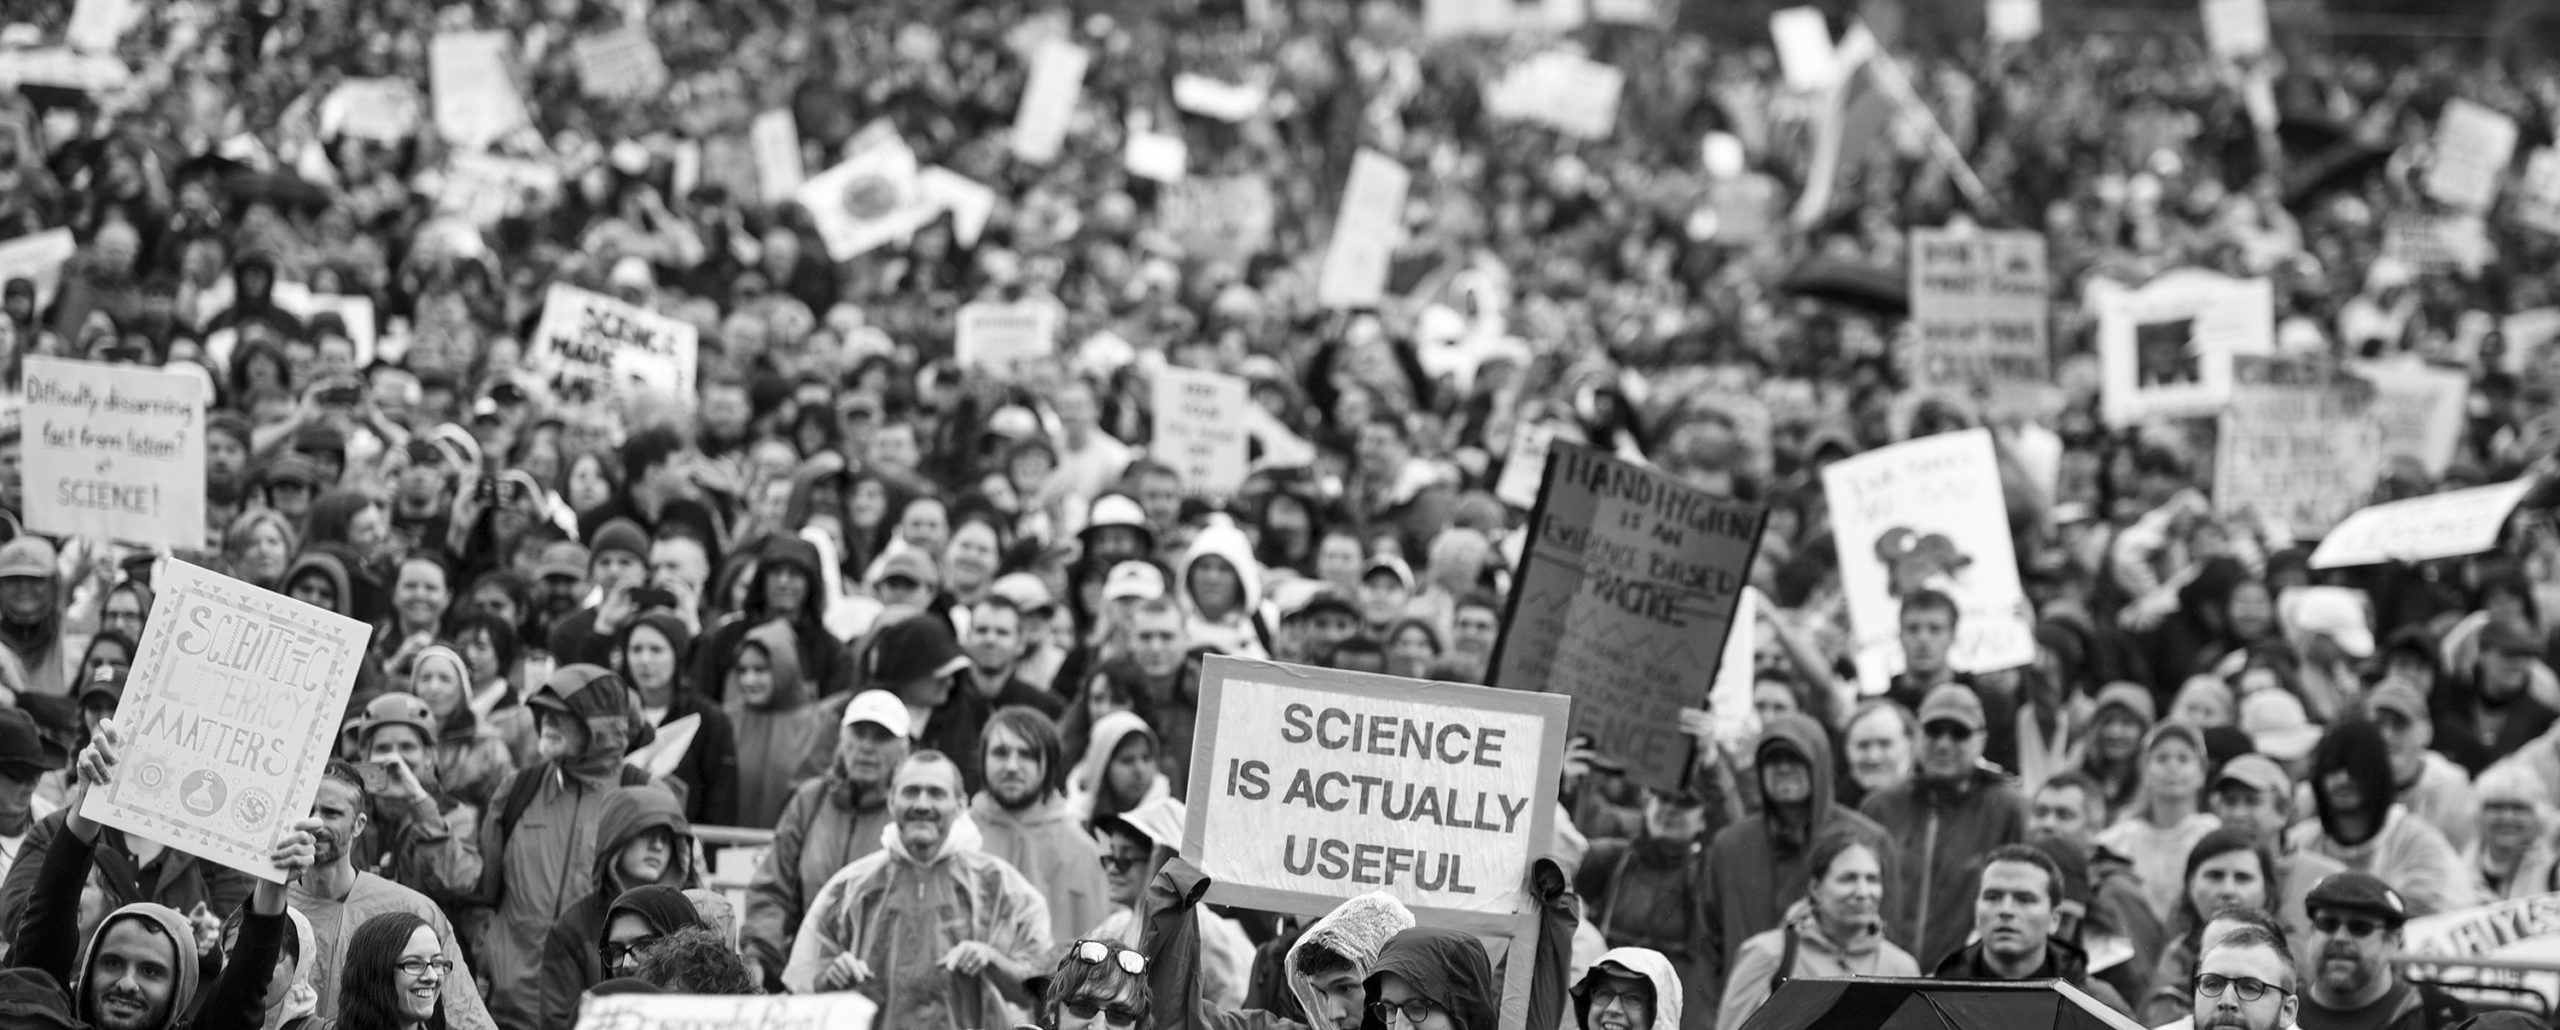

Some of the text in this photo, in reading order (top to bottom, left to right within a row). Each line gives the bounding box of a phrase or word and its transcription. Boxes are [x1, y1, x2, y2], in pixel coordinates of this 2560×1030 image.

[1619, 509, 1684, 549] IS AN
[1649, 551, 1737, 596] BASED
[175, 605, 331, 692] SCIENTIFIC
[158, 655, 311, 732] LITERACY
[140, 703, 289, 777] MATTERS
[1281, 703, 1506, 768] SCIENCE
[1227, 758, 1529, 833] IS ACTUALLY
[1283, 835, 1476, 894] USEFUL
